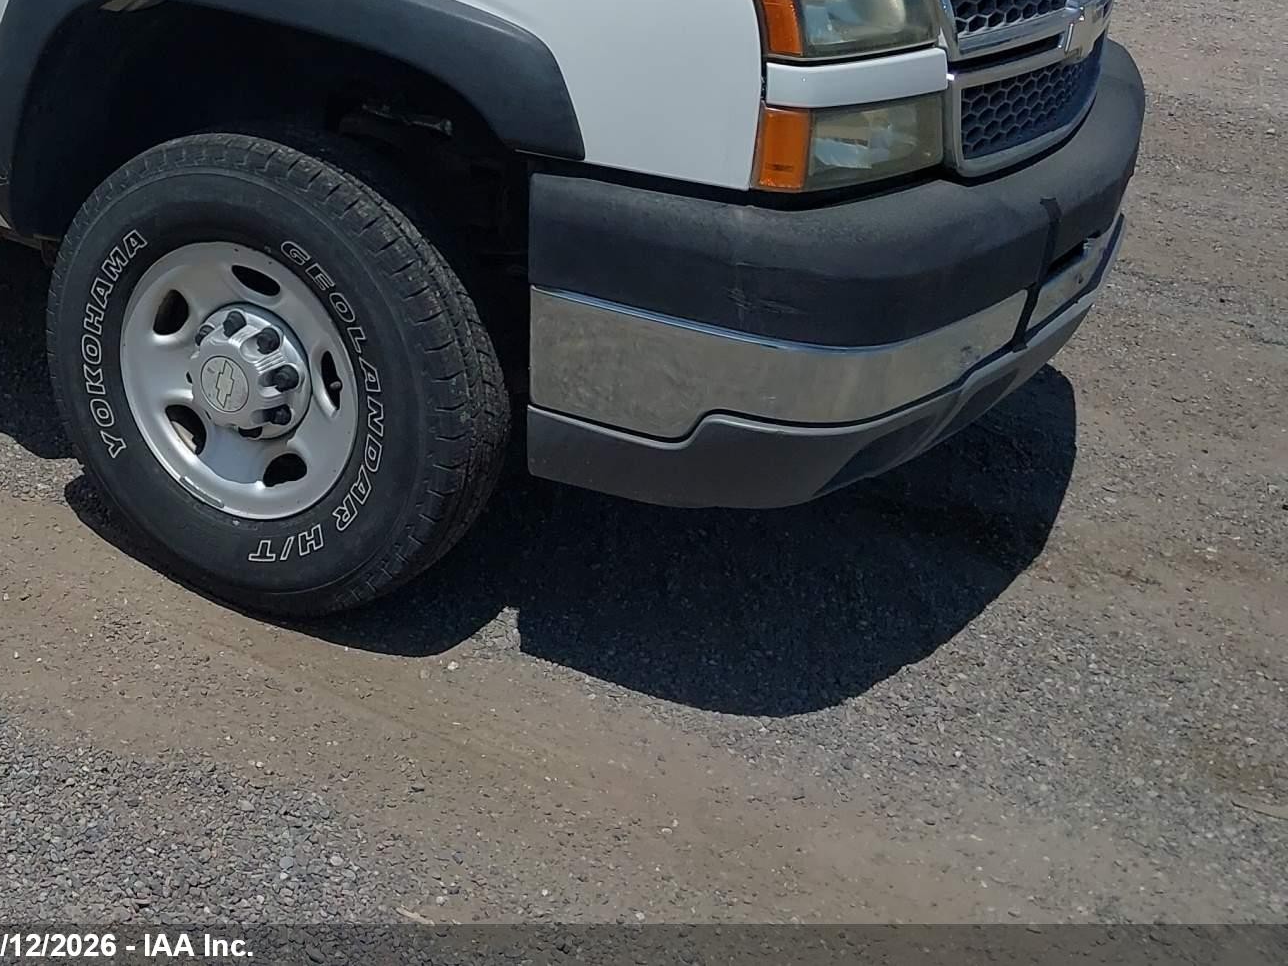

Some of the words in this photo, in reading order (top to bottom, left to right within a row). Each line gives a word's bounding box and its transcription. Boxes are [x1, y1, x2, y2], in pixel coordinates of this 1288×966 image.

[81, 229, 148, 459] YOKOHAMA
[280, 241, 385, 531] GEOLANDAR
[248, 524, 324, 562] H/T
